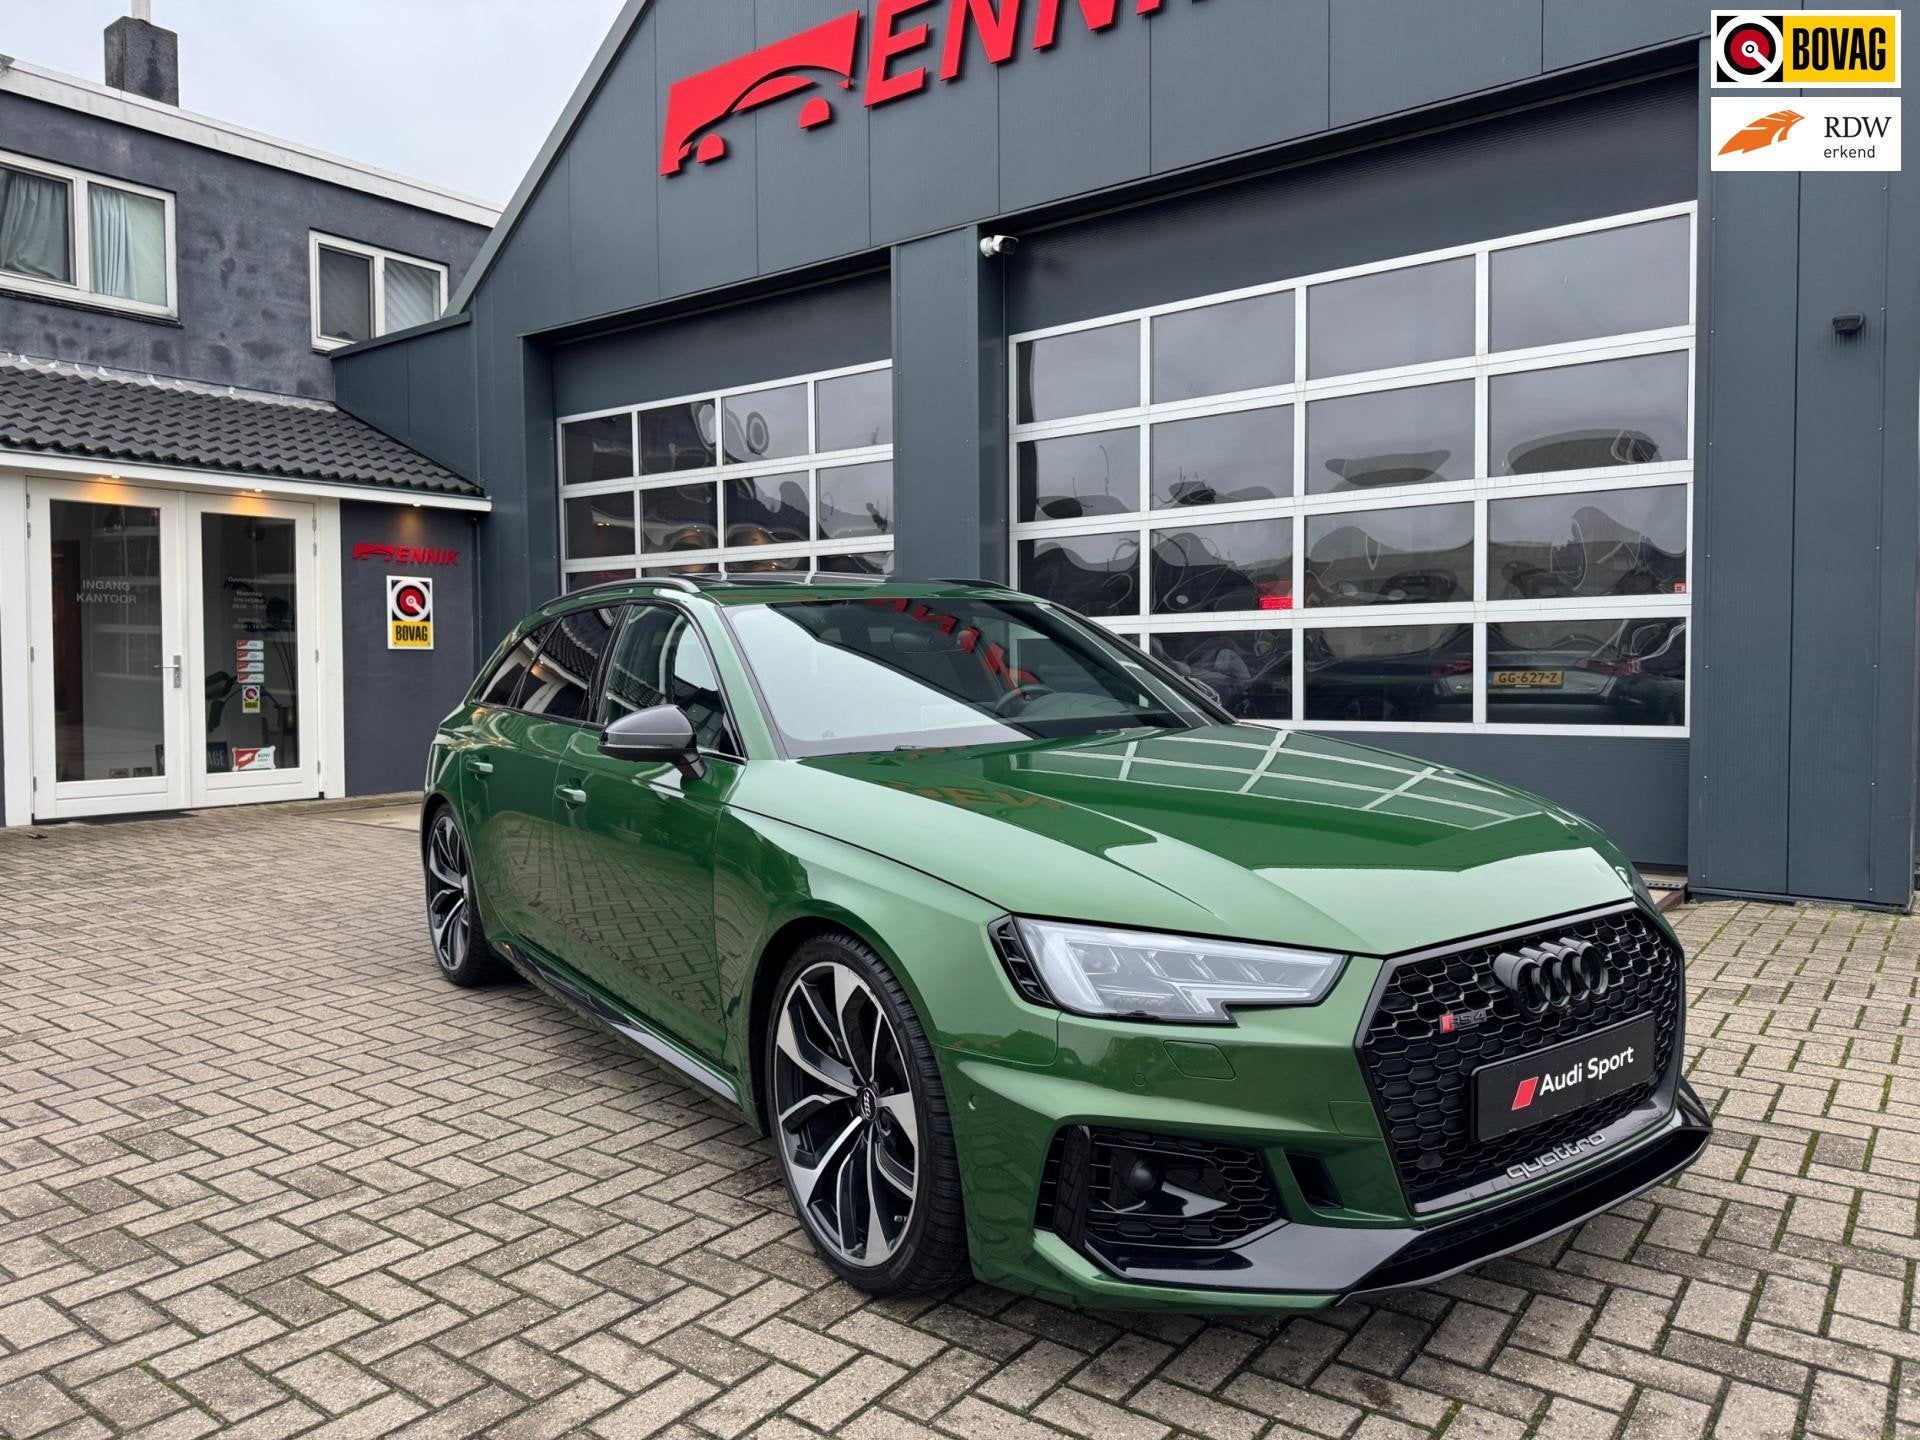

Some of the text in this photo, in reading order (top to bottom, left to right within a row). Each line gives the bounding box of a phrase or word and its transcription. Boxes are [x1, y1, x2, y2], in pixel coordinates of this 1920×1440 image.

[82, 579, 130, 591] INGANG
[76, 592, 137, 604] KANTOOR
[395, 625, 428, 641] BOVAG
[1498, 672, 1558, 684] GG-627-Z
[1539, 1046, 1634, 1096] Audi Sport
[1506, 1132, 1606, 1179] quattro
